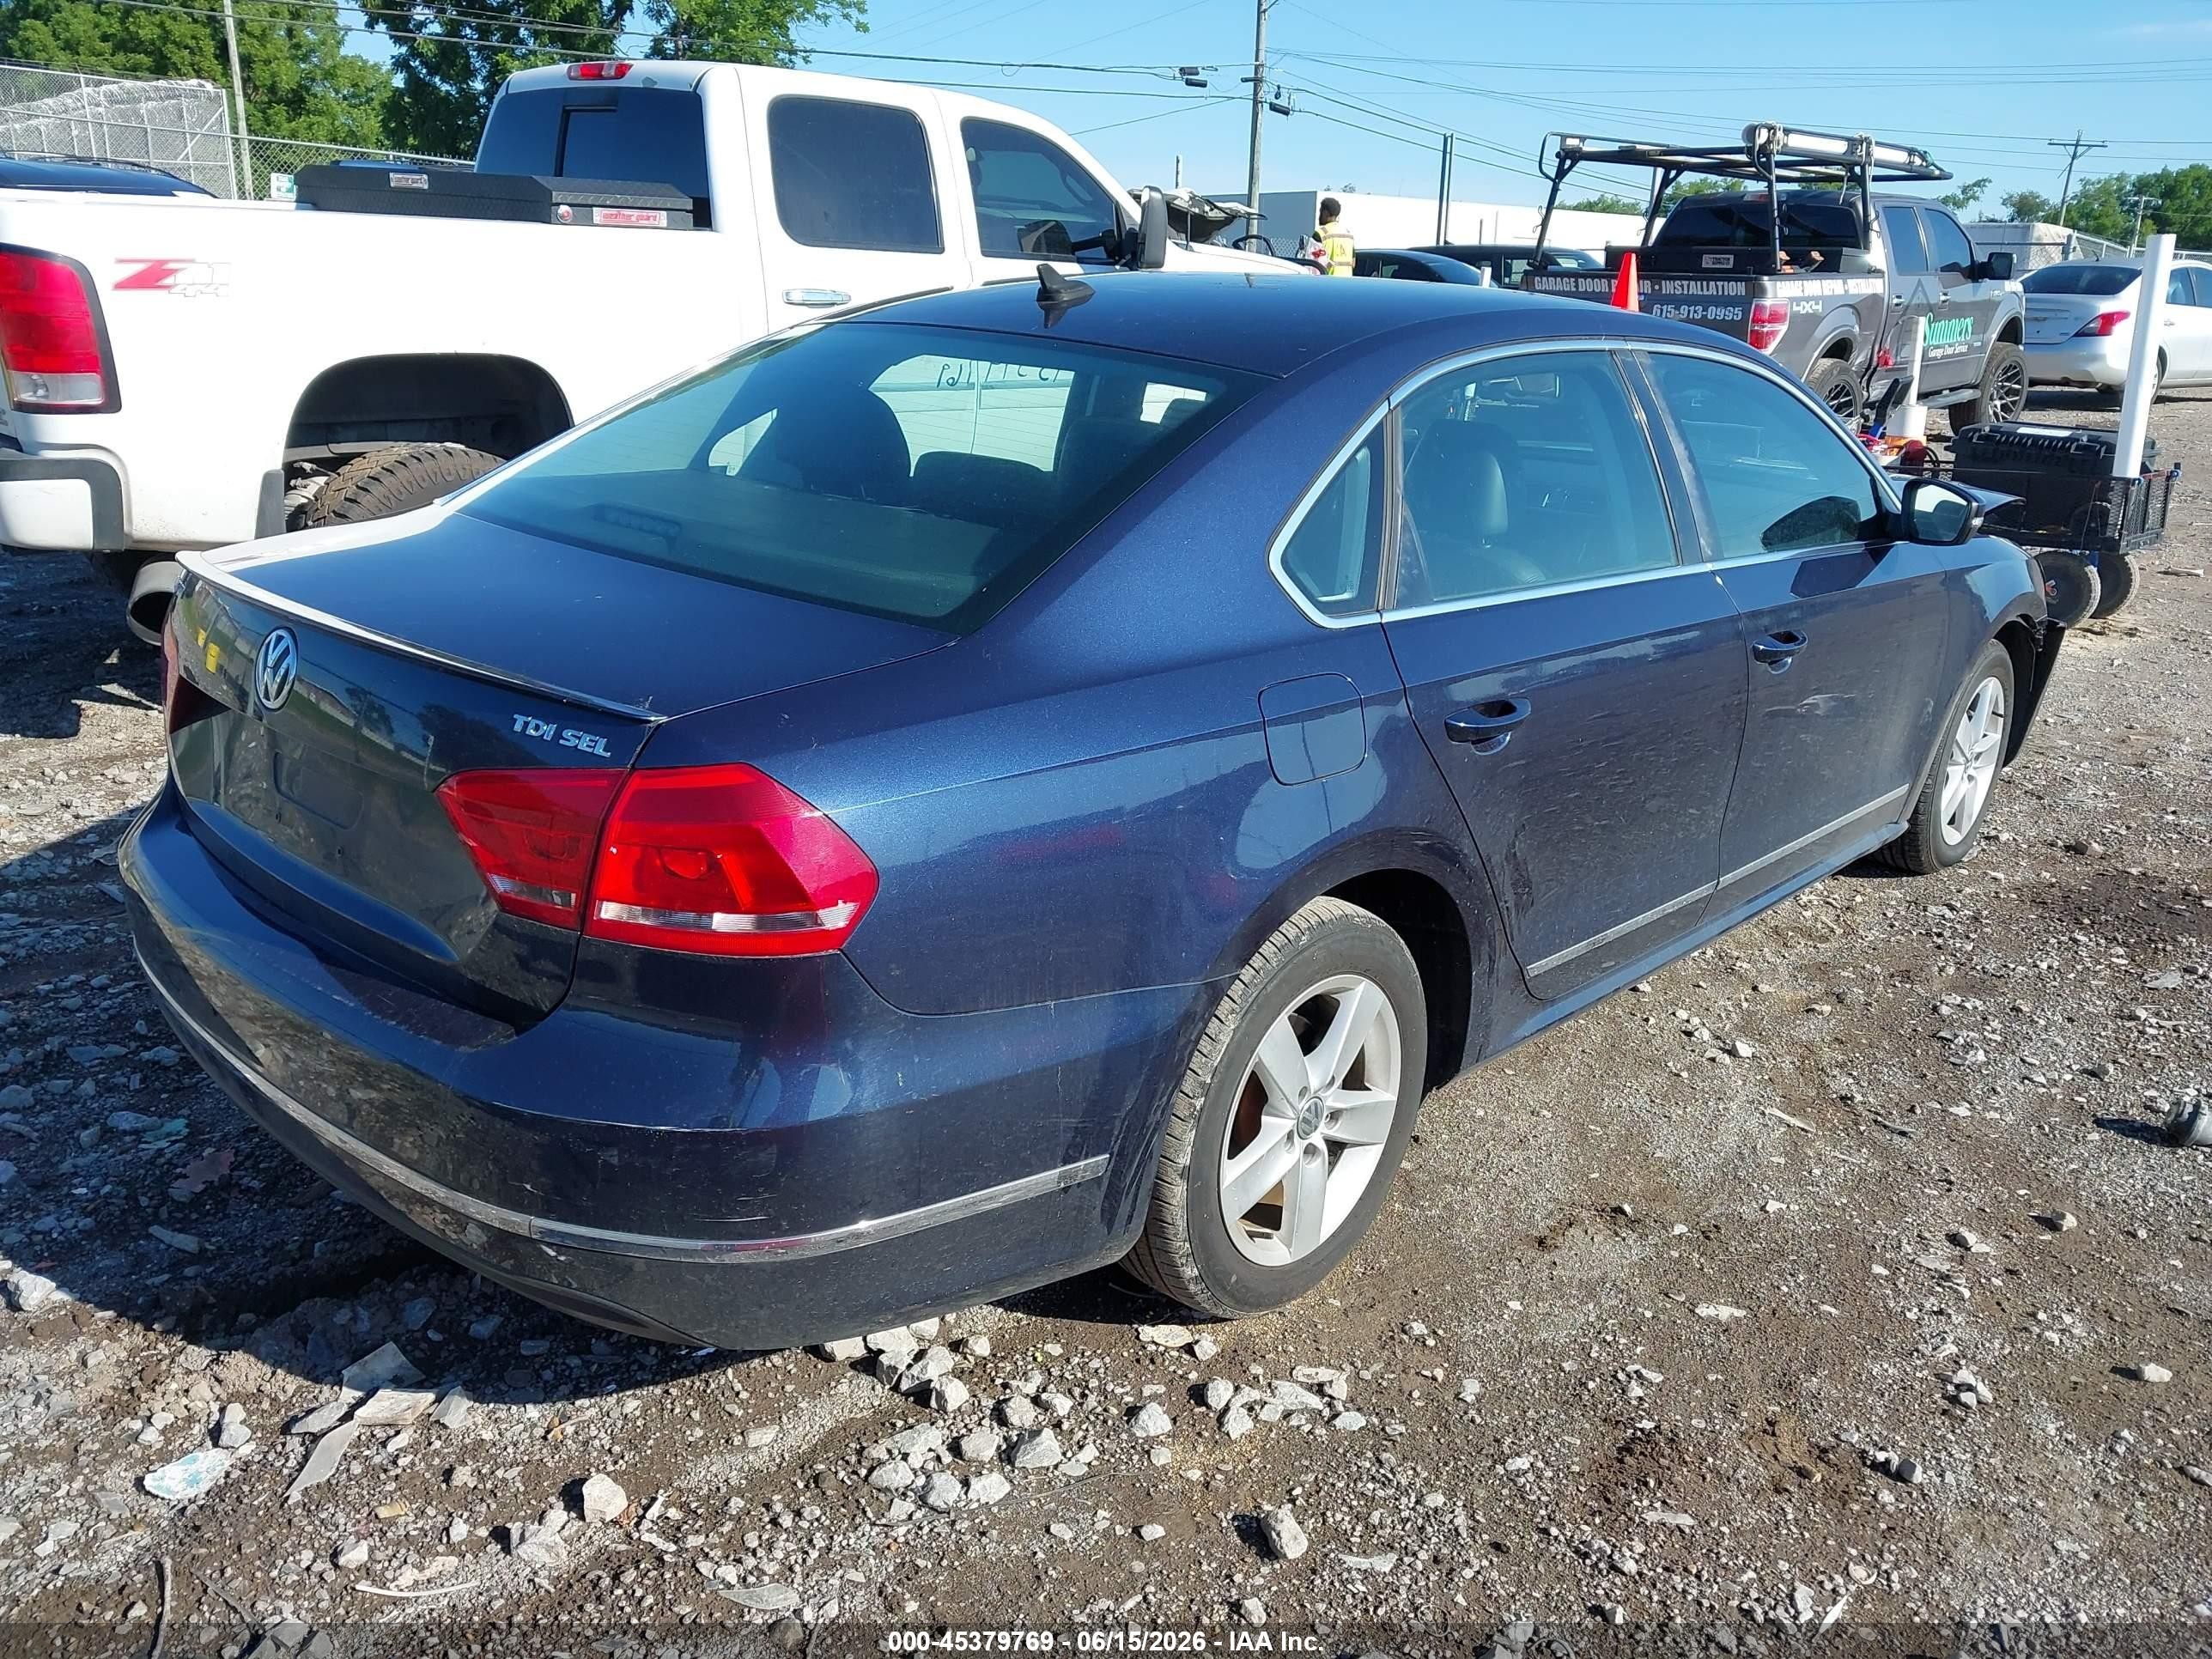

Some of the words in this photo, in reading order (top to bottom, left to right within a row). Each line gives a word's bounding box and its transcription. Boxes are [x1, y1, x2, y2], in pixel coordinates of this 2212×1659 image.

[1534, 276, 1577, 292] GARAGE
[1578, 278, 1609, 293] DOOR
[1662, 280, 1746, 296] INSTALLATION
[1652, 304, 1743, 321] 615-913-0995
[1923, 312, 1974, 346] Summers
[1928, 346, 1944, 360] Garage
[1943, 343, 1955, 356] Door
[513, 714, 557, 741] TDI
[558, 729, 611, 758] SEL
